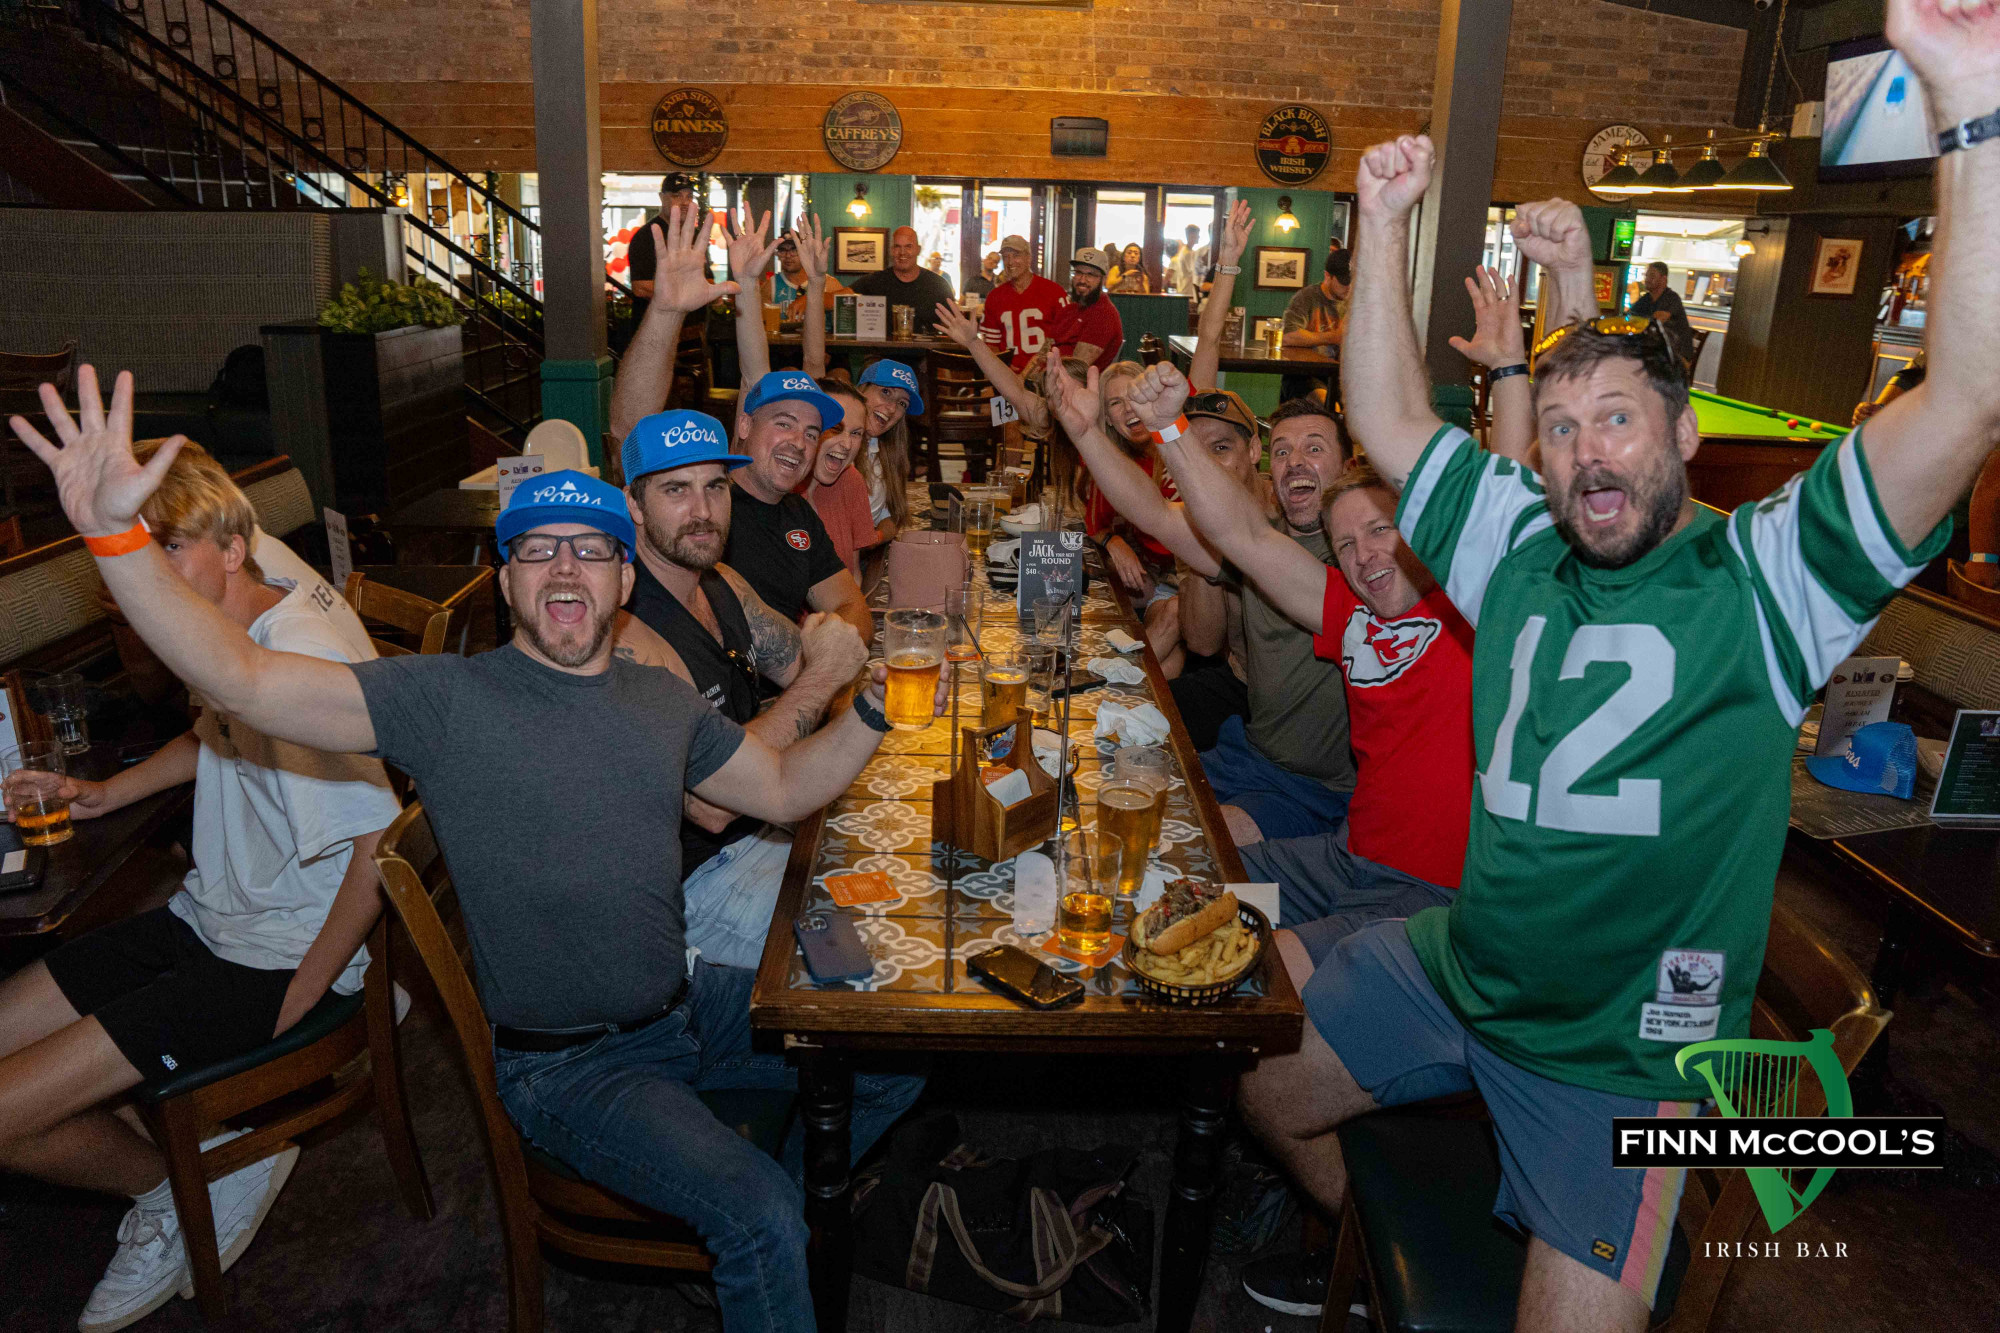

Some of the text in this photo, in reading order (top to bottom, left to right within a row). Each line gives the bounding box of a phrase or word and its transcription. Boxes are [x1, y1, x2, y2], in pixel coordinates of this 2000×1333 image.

[661, 91, 719, 113] EXTRA STOUT
[653, 118, 725, 133] GUINNESS
[1261, 108, 1327, 139] BLACK BUSH
[826, 127, 900, 141] CAFFREY'S
[1280, 157, 1306, 166] IRISH
[1270, 165, 1315, 175] WHISKEY
[1000, 308, 1046, 355] 16
[995, 400, 1014, 418] 15
[661, 426, 719, 448] Coors
[1028, 544, 1055, 557] JACK
[1477, 615, 1676, 837] 12
[1646, 1017, 1663, 1026] NEW
[1664, 1019, 1681, 1027] YORK
